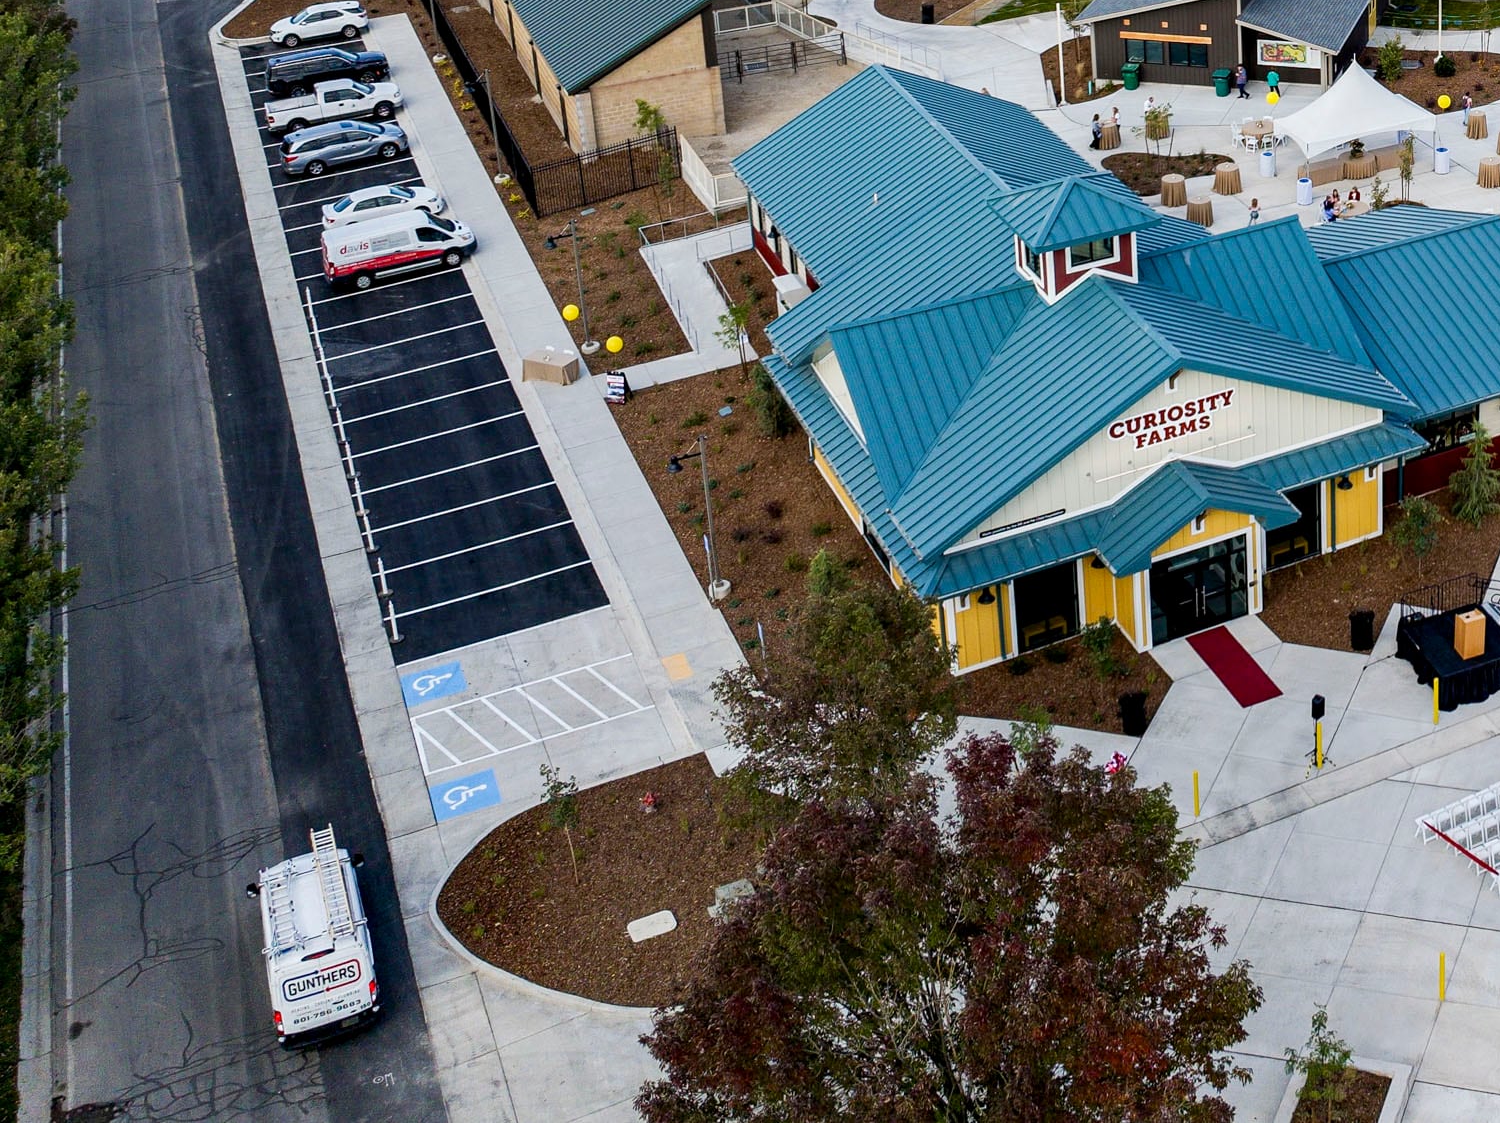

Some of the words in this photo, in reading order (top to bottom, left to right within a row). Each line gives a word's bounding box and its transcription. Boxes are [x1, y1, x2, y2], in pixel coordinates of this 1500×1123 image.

[339, 240, 369, 255] davis
[1109, 389, 1234, 439] CURIOSITY
[1135, 415, 1212, 449] FARMS
[288, 964, 356, 996] GUNTHERS
